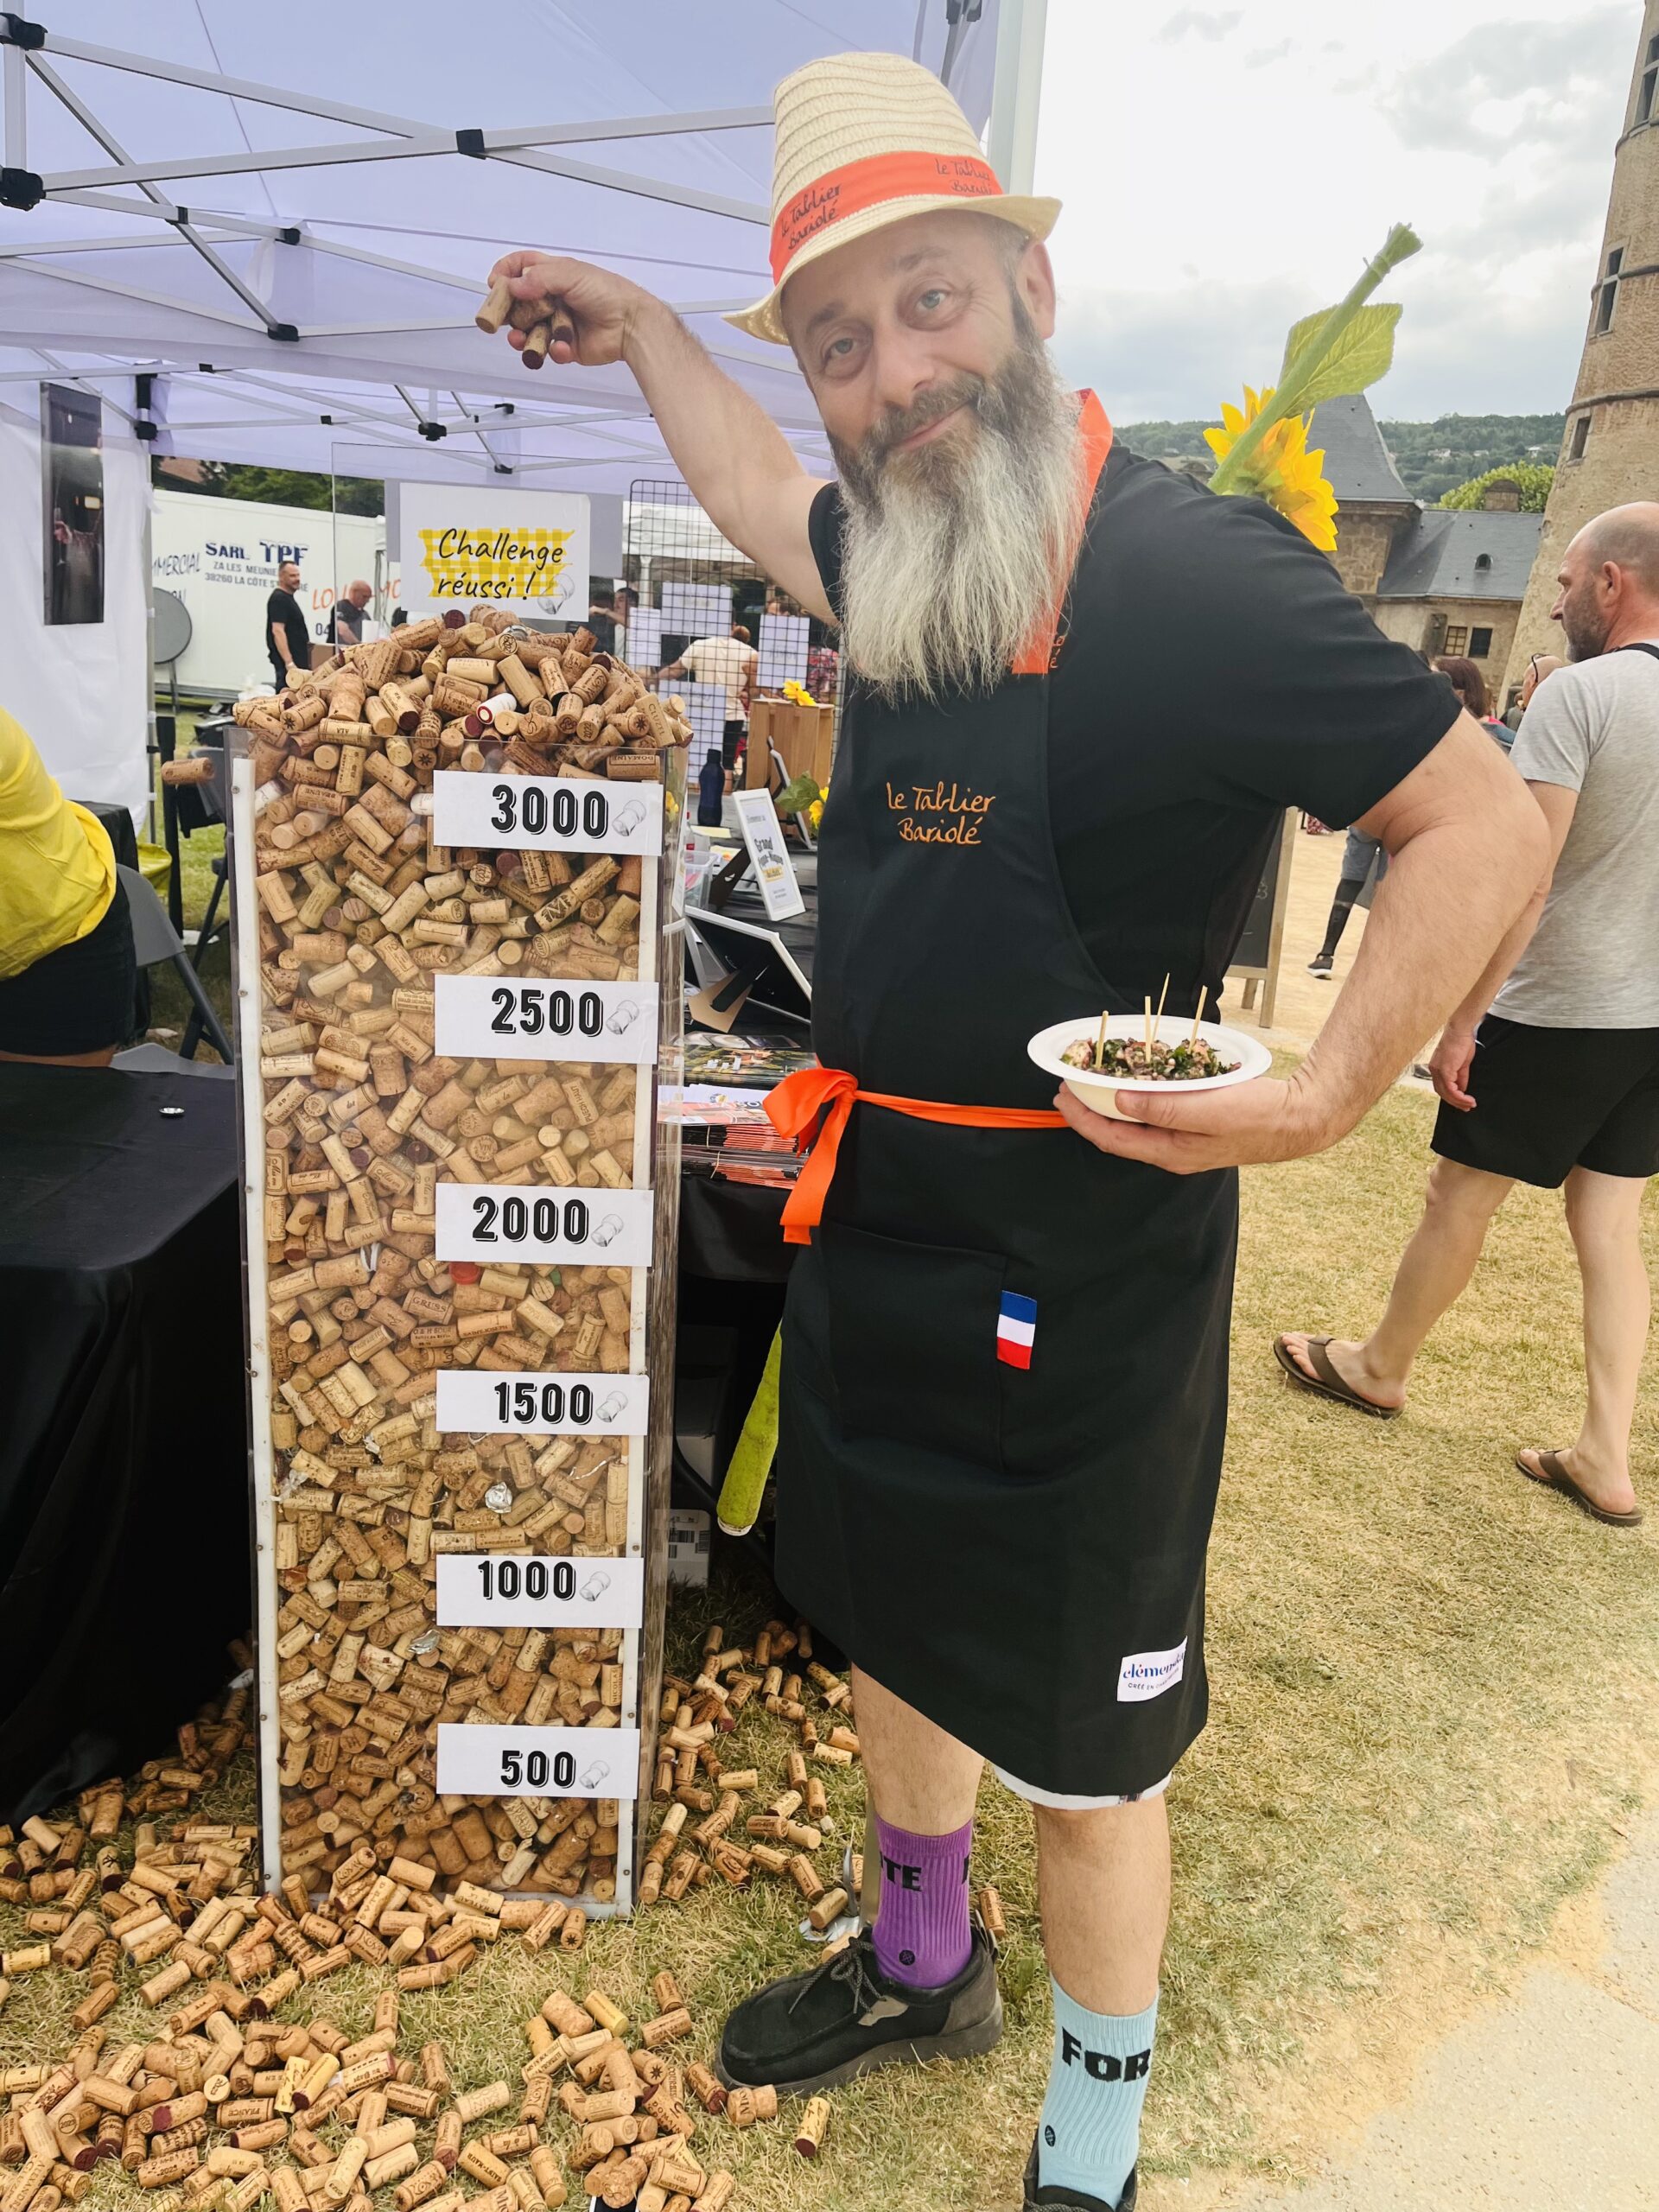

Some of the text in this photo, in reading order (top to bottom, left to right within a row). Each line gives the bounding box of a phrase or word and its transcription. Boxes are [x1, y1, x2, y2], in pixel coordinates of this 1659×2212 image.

[206, 541, 251, 560] SARL
[438, 528, 563, 571] Challenge
[246, 565, 277, 576] MEUNIE
[437, 572, 515, 599] réussi
[490, 784, 608, 839] 3000
[912, 780, 996, 812] Tablier
[897, 815, 982, 844] Bariolé
[491, 988, 604, 1037] 2500
[472, 1196, 588, 1244] 2000
[494, 1382, 593, 1425] 1500
[478, 1560, 576, 1600] 1000
[500, 1750, 576, 1789] 500
[1062, 2026, 1151, 2082] FOR
[467, 2152, 502, 2183] SAINT-MAUR
